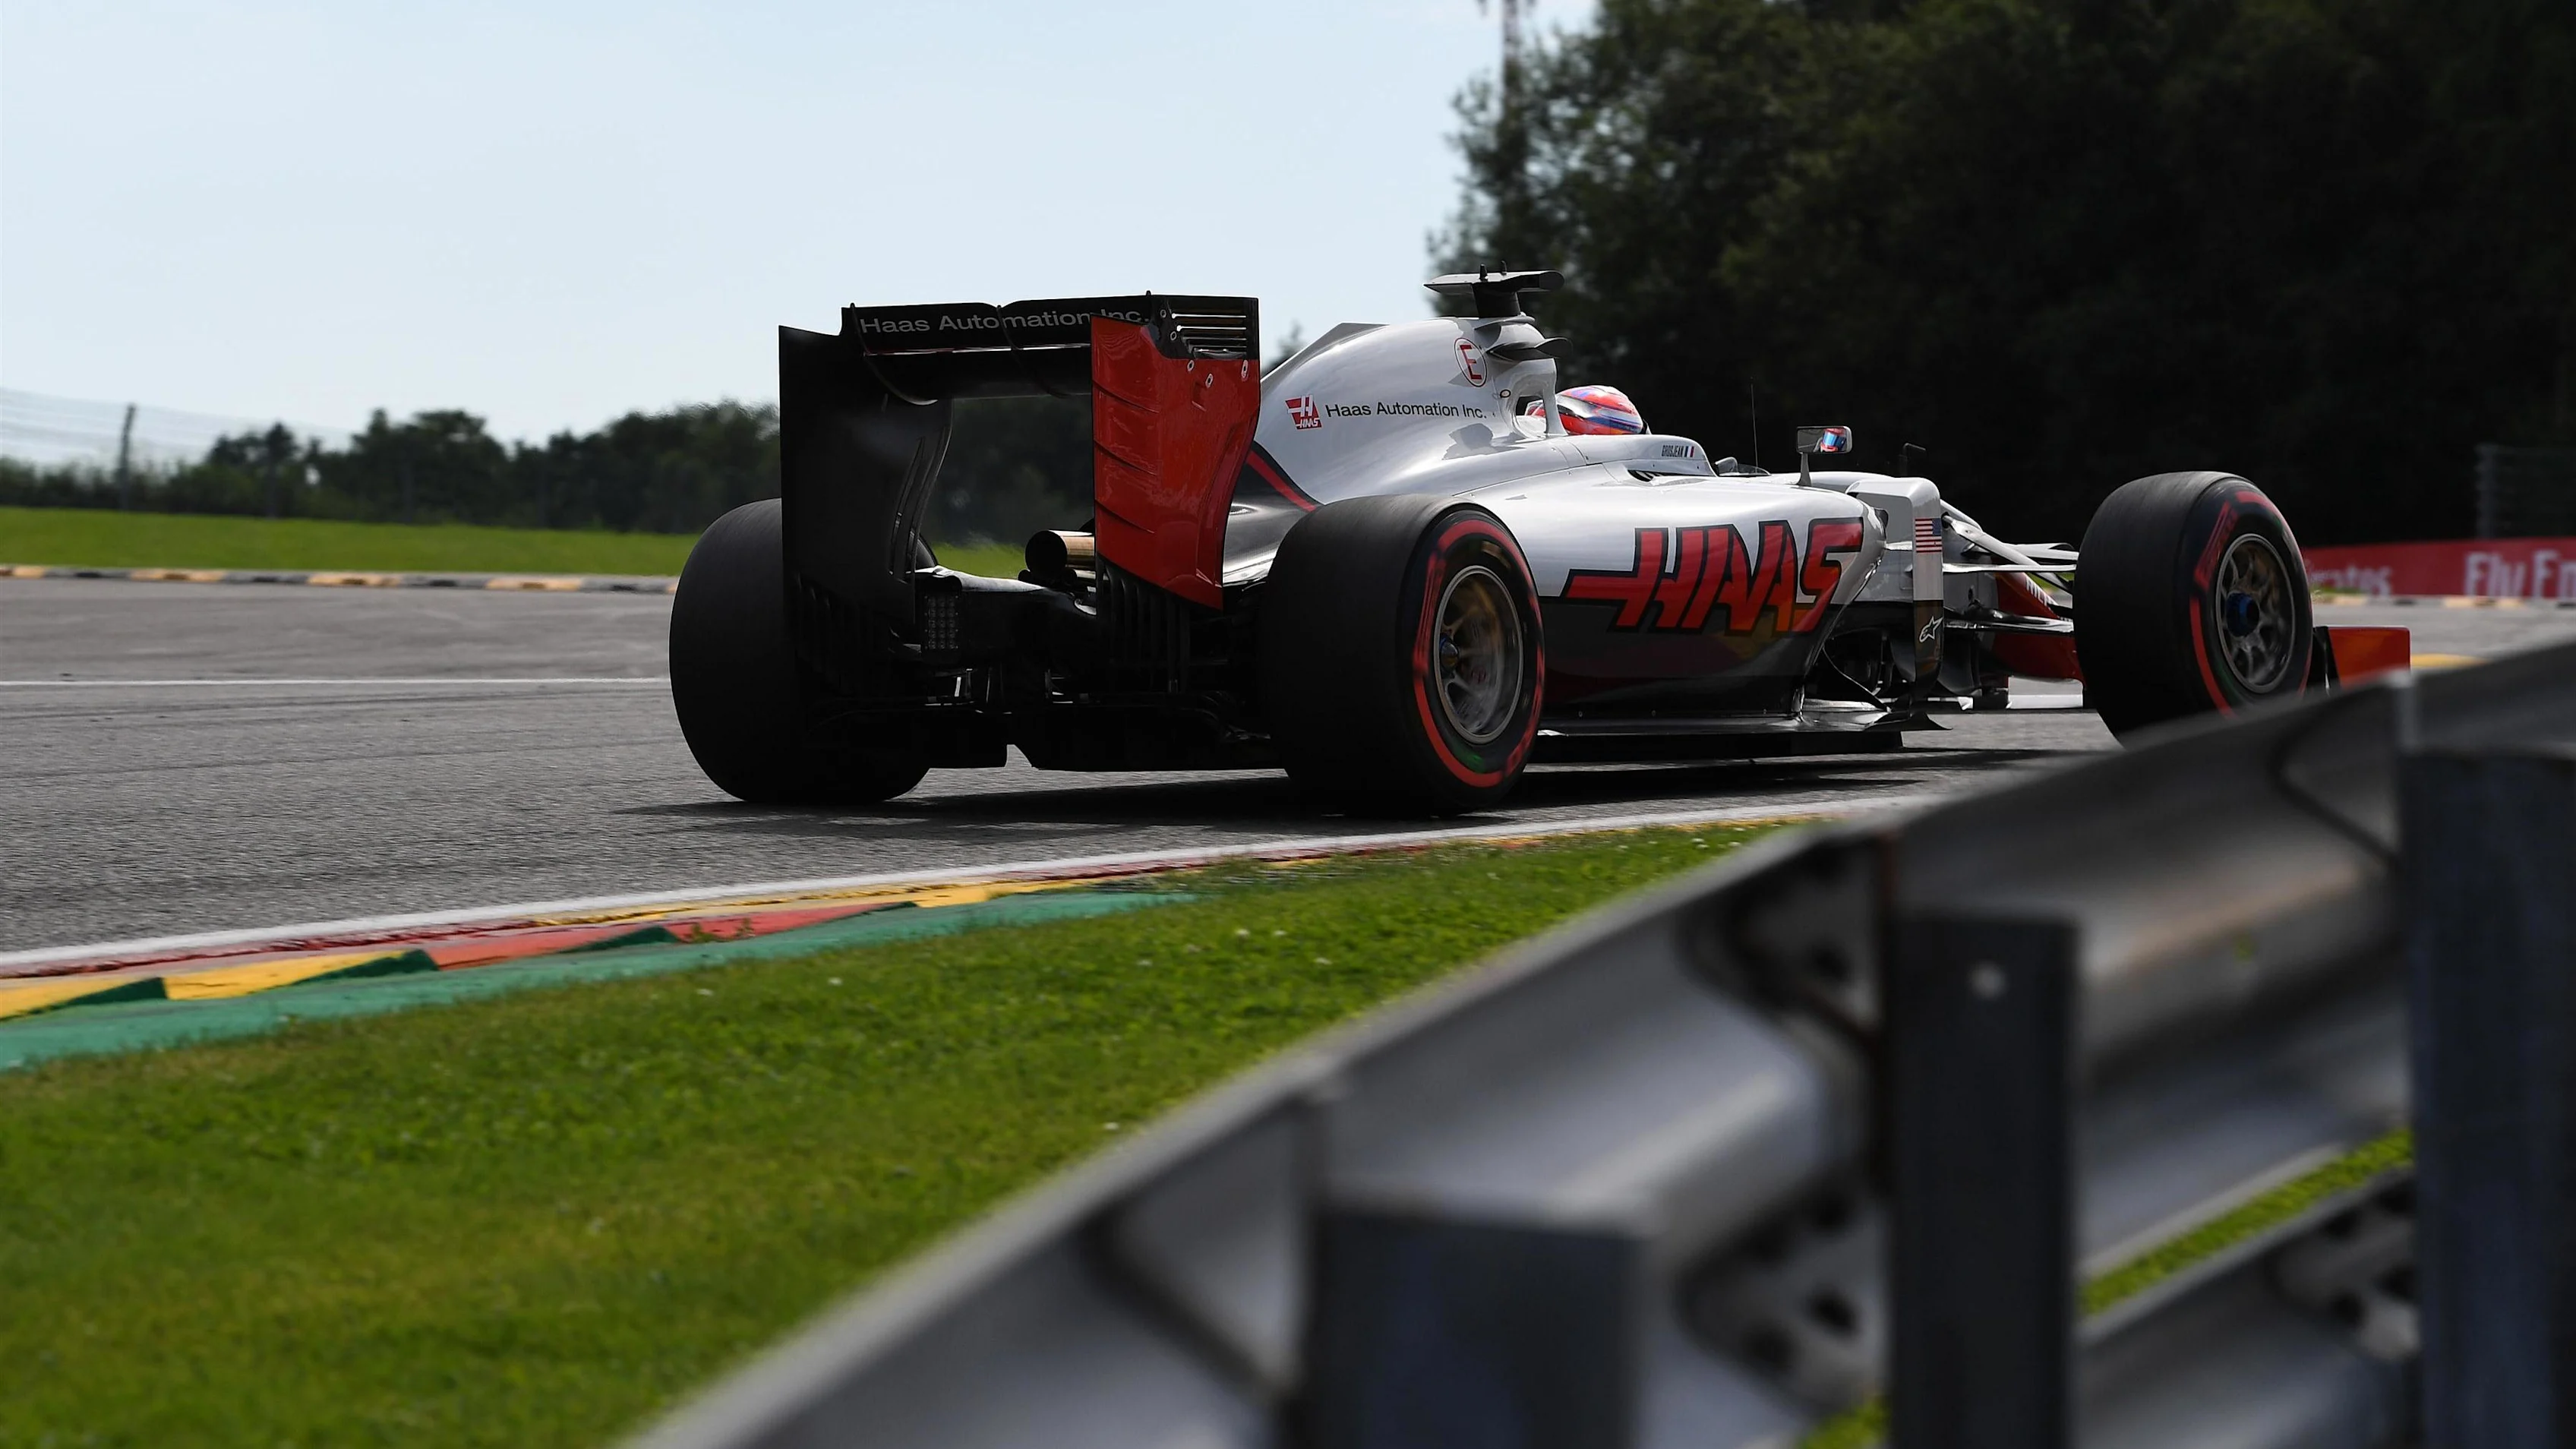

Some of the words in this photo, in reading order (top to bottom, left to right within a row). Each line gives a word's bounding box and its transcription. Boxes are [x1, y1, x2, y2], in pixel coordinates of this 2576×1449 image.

[860, 317, 930, 333] Haas
[939, 310, 1091, 331] Automation
[1459, 344, 1482, 380] E
[1325, 404, 1372, 417] Haas
[1377, 402, 1460, 417] Automation
[1463, 404, 1487, 418] Inc.
[1563, 516, 1864, 634] HAAS
